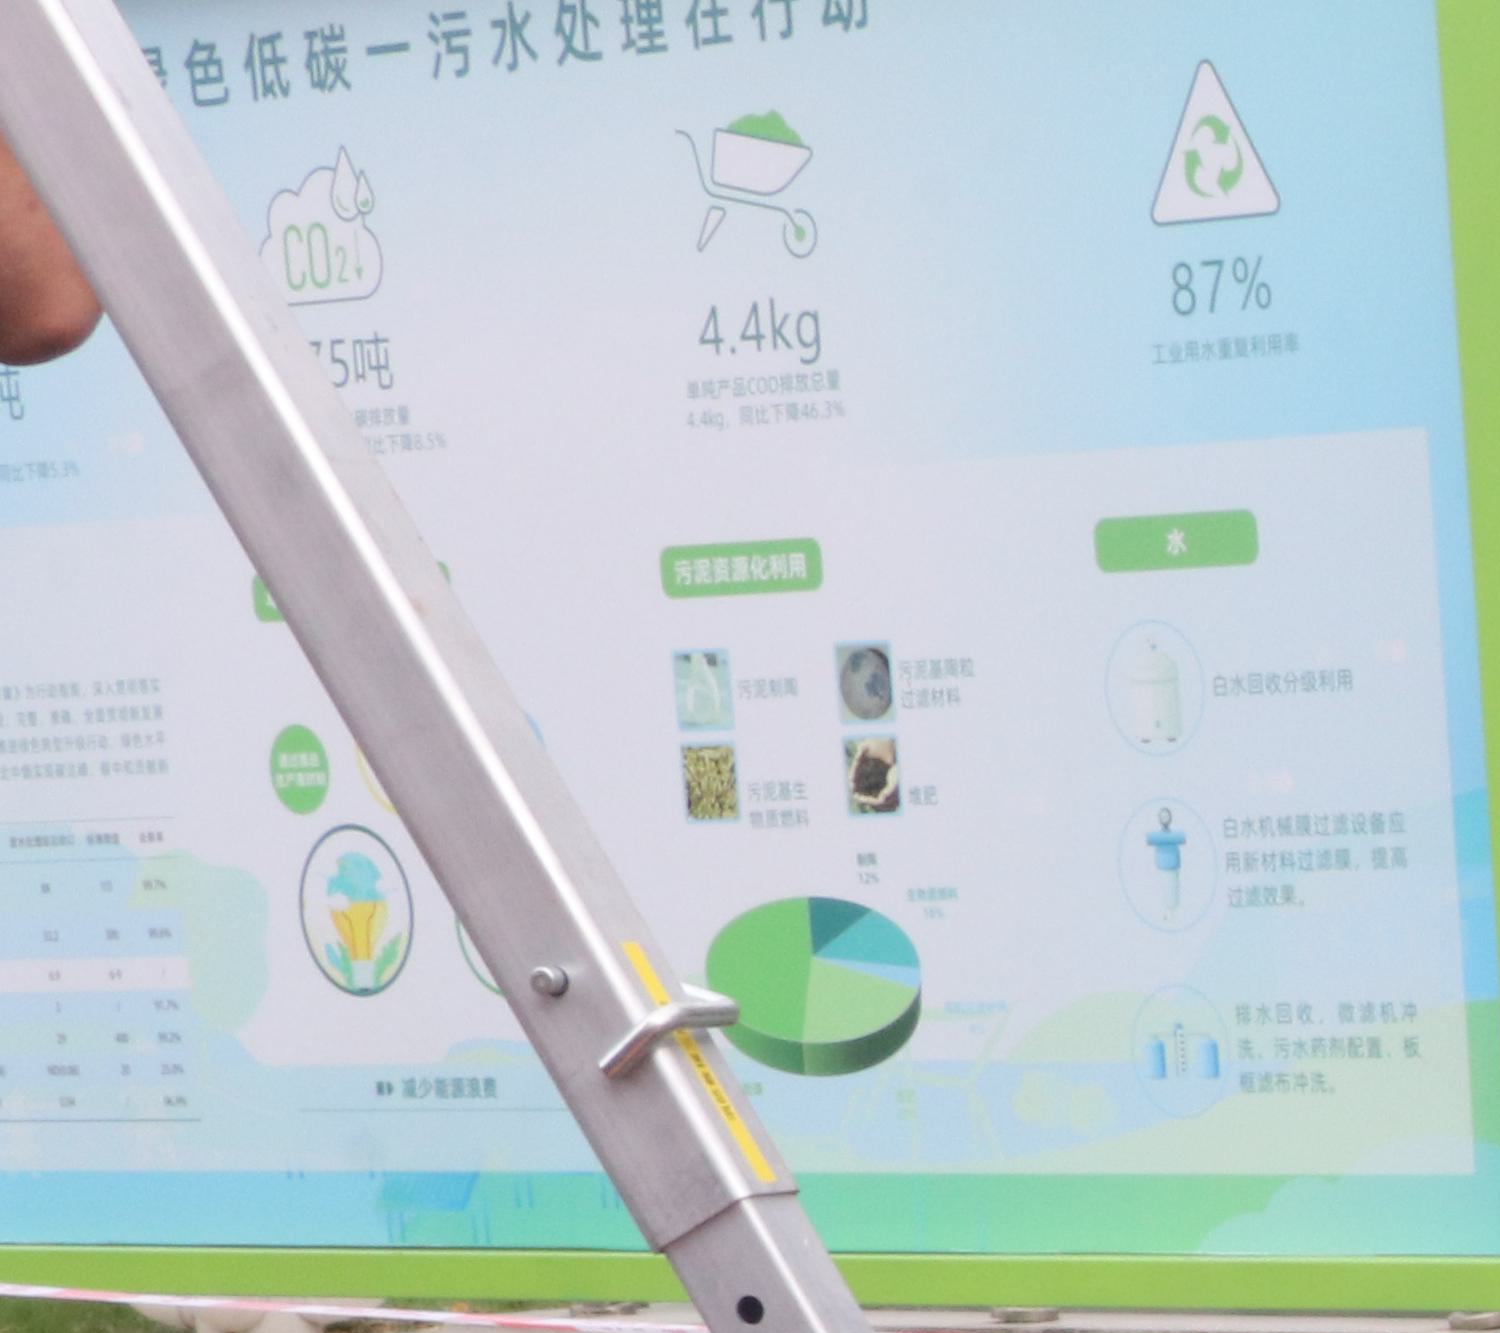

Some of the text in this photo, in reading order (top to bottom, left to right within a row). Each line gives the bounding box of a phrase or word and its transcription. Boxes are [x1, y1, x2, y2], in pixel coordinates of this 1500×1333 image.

[1171, 256, 1272, 316] 87%
[698, 297, 822, 365] 4.4kg
[1167, 528, 1187, 556] 水
[673, 551, 807, 586] 污泥资源化利用
[738, 677, 798, 700] 污泥制陶
[1213, 669, 1353, 697] 白水回收分级利用
[901, 687, 960, 709] 过滤材料
[1223, 812, 1407, 838] 白水机械膜过滤设备应
